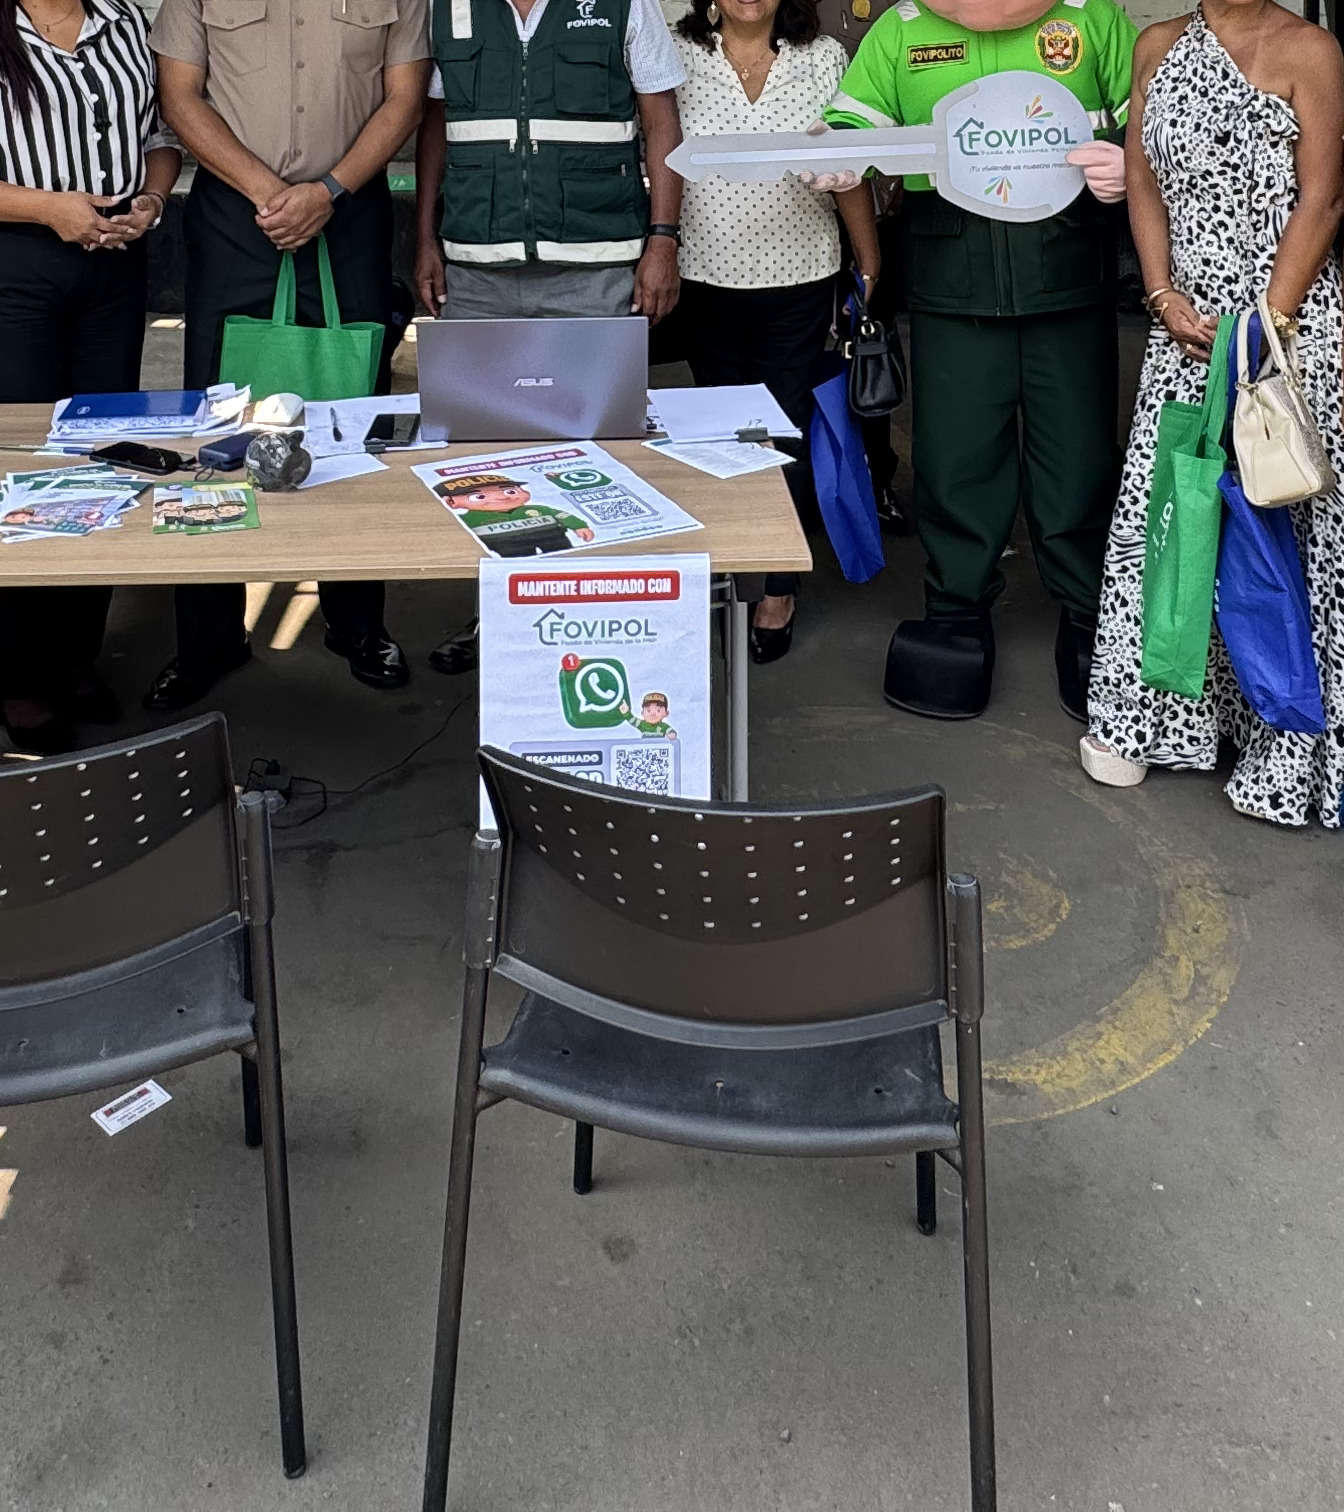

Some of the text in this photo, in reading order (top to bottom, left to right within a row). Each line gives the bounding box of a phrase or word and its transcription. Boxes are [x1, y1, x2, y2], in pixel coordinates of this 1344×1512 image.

[567, 18, 612, 29] FOVIPOL
[910, 47, 963, 62] FOVIPOLITO
[967, 126, 1077, 149] FOVIPOL
[514, 378, 554, 387] ASUS
[517, 577, 672, 597] MANTENTE INFORMADO CON
[549, 618, 658, 639] FOVIPOL
[568, 656, 575, 667] 1
